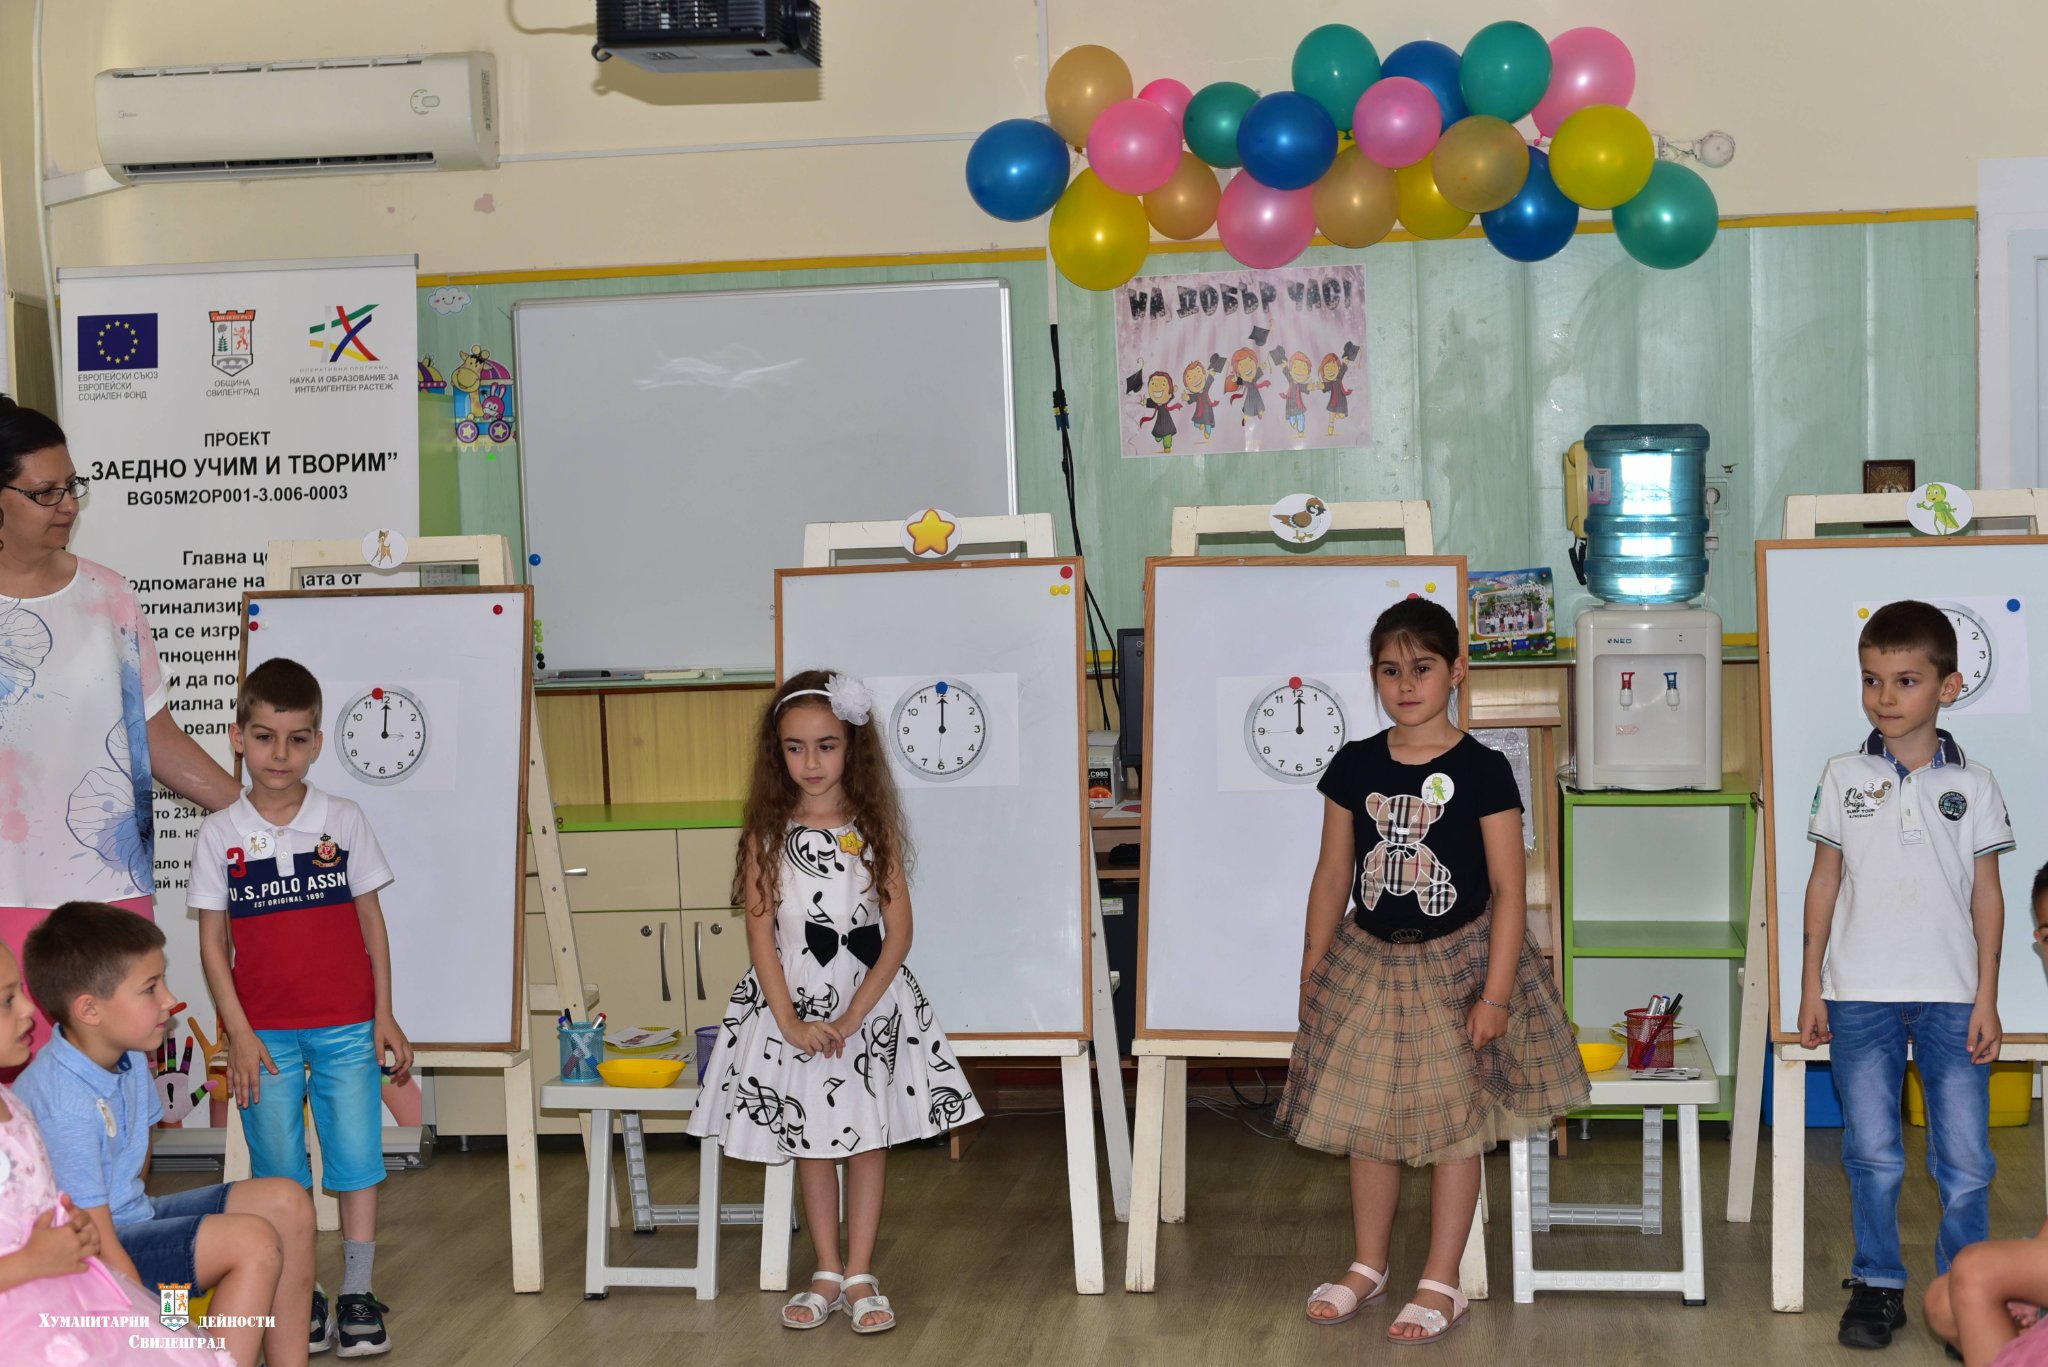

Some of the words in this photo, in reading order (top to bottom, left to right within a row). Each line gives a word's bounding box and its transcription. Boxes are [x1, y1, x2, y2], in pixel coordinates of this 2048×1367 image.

[1127, 286, 1166, 320] НА
[1176, 279, 1277, 319] ДОБЪР
[78, 372, 132, 382] ЕВРОПЕЙСКИ
[133, 371, 159, 380] СЪЮЗ
[289, 375, 317, 384] НАУКА
[325, 373, 386, 383] ОБРАЗОВАНИЕ
[388, 373, 399, 381] ЗА
[78, 382, 132, 392] ЕВРОПЕЙСКИ
[214, 379, 251, 388] ОБЩИНА
[295, 384, 357, 394] ИНТЕЛИГЕНТЕН
[358, 382, 394, 392] РАСТЕЖ
[78, 391, 122, 402] СОЦИАЛЕН
[124, 391, 147, 401] ФОНД
[205, 388, 260, 397] СВИЛЕНГРАД
[204, 431, 271, 447] ПРОЕКТ
[193, 455, 258, 478] УЧИМ
[265, 456, 281, 475] И
[183, 551, 247, 566] Главна
[127, 576, 237, 593] одпомагане
[244, 576, 265, 588] на
[341, 574, 362, 586] от
[175, 626, 195, 638] се
[1971, 631, 1979, 640] 2
[160, 650, 240, 664] пноценн
[1979, 651, 1986, 659] 3
[1974, 670, 1981, 678] 4
[186, 674, 208, 689] да
[1962, 684, 1969, 692] 5
[1292, 689, 1304, 698] 12
[919, 695, 927, 703] 11
[1275, 695, 1283, 703] 11
[364, 701, 372, 709] 11
[907, 708, 918, 716] 10
[968, 707, 975, 715] 2
[1263, 708, 1274, 717] 10
[1327, 707, 1334, 716] 2
[353, 713, 363, 722] 10
[410, 713, 417, 721] 2
[902, 726, 910, 735] 9
[974, 725, 980, 733] 3
[1258, 727, 1265, 735] 9
[1333, 726, 1340, 734] 3
[347, 731, 354, 739] 9
[414, 731, 421, 739] 3
[907, 744, 914, 753] 8
[968, 744, 975, 752] 4
[1263, 746, 1271, 754] 8
[1327, 745, 1335, 753] 4
[350, 749, 358, 757] 8
[408, 749, 415, 757] 4
[921, 758, 928, 766] 7
[937, 761, 945, 770] 6
[956, 757, 964, 765] 5
[1278, 759, 1285, 768] 7
[1315, 758, 1322, 766] 5
[363, 762, 370, 770] 7
[378, 766, 386, 774] 6
[397, 762, 403, 770] 5
[1295, 763, 1303, 772] 6
[174, 807, 196, 819] 234
[160, 830, 181, 839] лв.
[259, 837, 267, 849] 3
[152, 860, 179, 869] ало
[227, 847, 248, 878] 3
[307, 871, 347, 891] ASSN
[254, 899, 266, 909] EST
[267, 896, 303, 907] ORIGINAL
[306, 892, 325, 901] 1890
